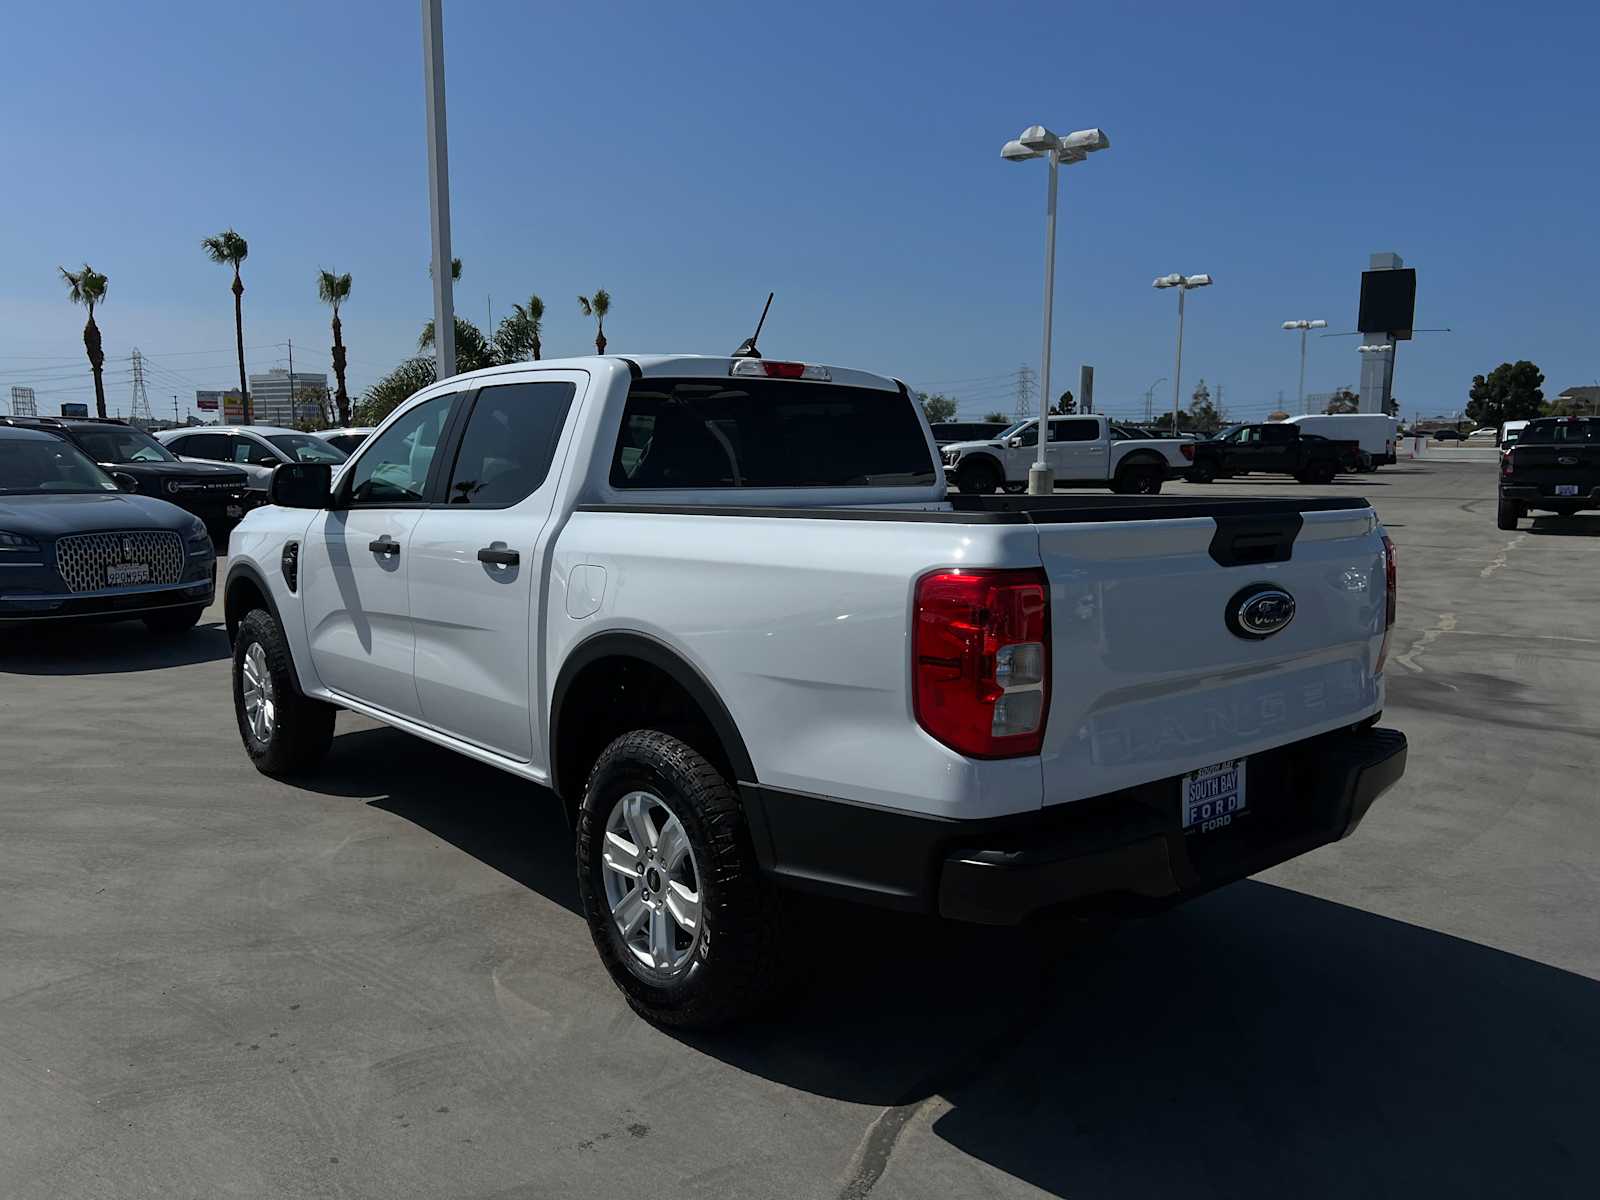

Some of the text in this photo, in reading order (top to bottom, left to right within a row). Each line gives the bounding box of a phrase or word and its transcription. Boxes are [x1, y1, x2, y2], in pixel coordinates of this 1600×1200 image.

[1094, 674, 1366, 765] RANGE
[1190, 770, 1237, 801] SOUTH BAY
[1191, 797, 1236, 822] FORD
[1201, 815, 1232, 833] FORD
